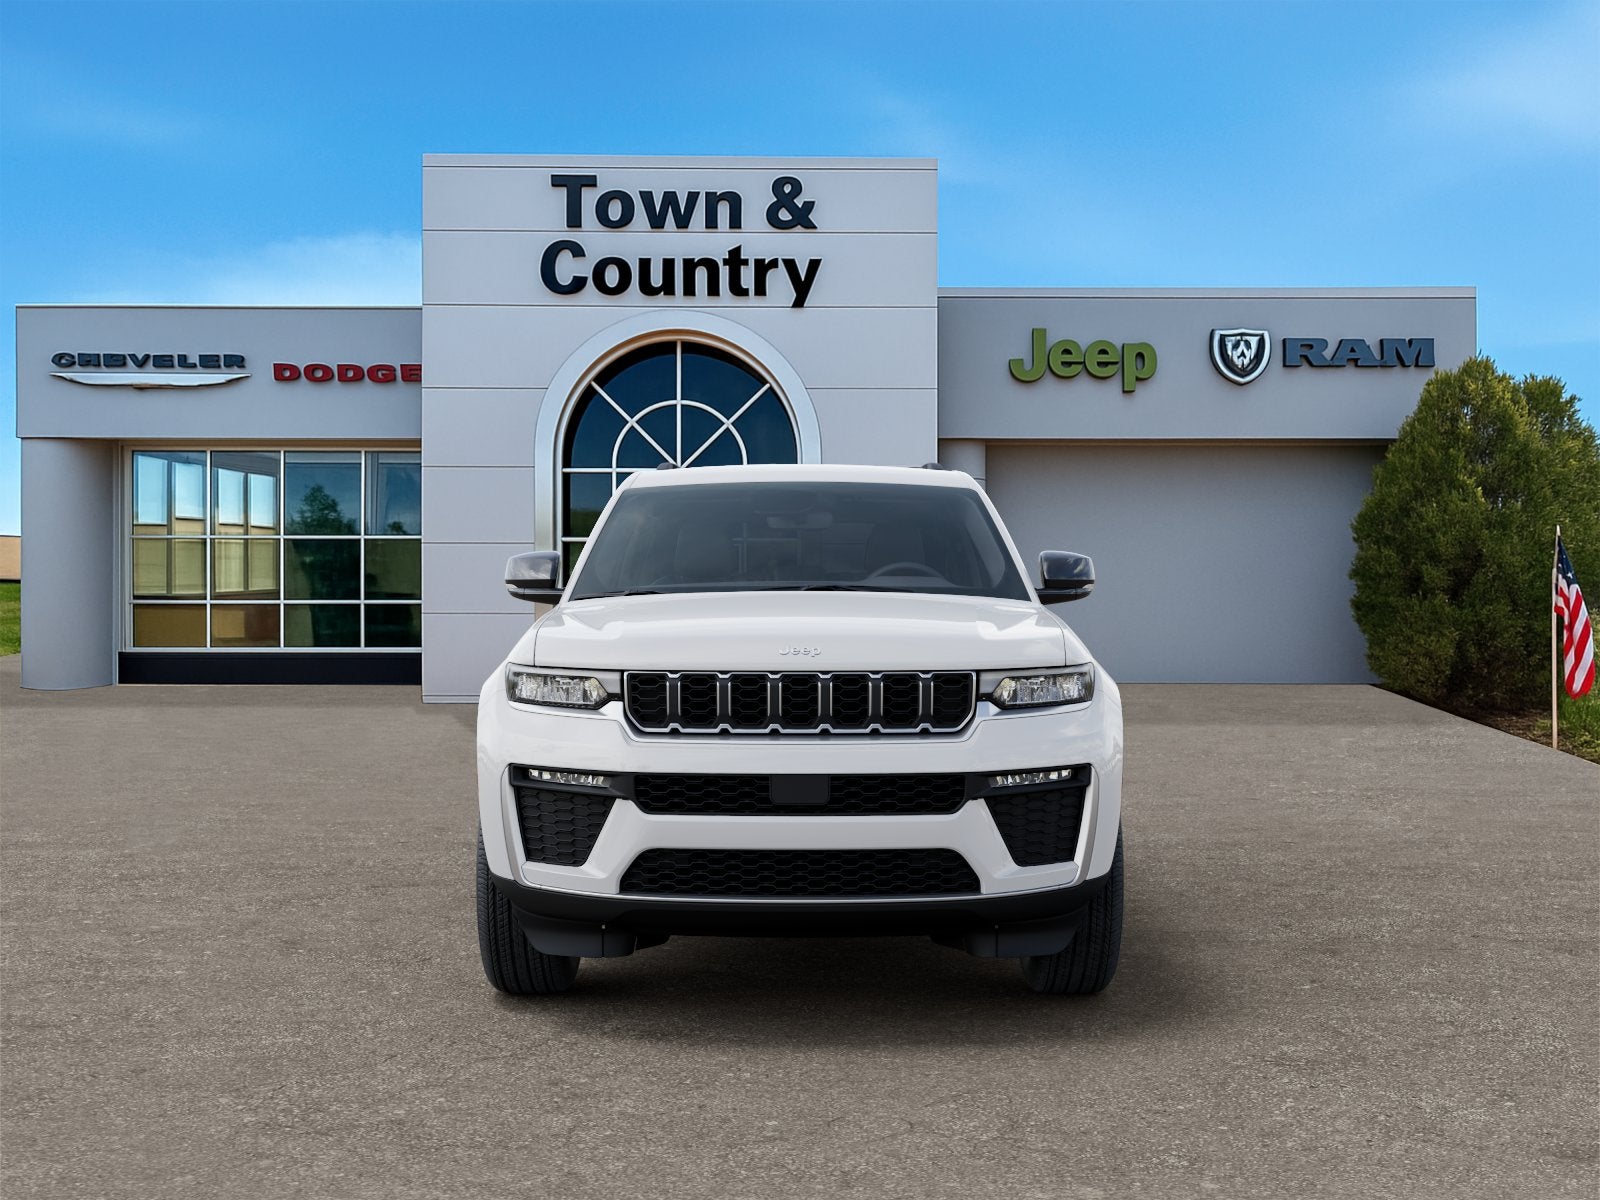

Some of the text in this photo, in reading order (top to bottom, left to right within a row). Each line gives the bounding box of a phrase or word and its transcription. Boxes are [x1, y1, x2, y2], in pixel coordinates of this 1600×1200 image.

[550, 174, 818, 230] Town &
[540, 239, 822, 308] Country
[272, 362, 422, 384] DODGE
[1008, 327, 1158, 393] Jeep
[1283, 337, 1436, 368] RAM
[778, 643, 822, 658] Jeep
